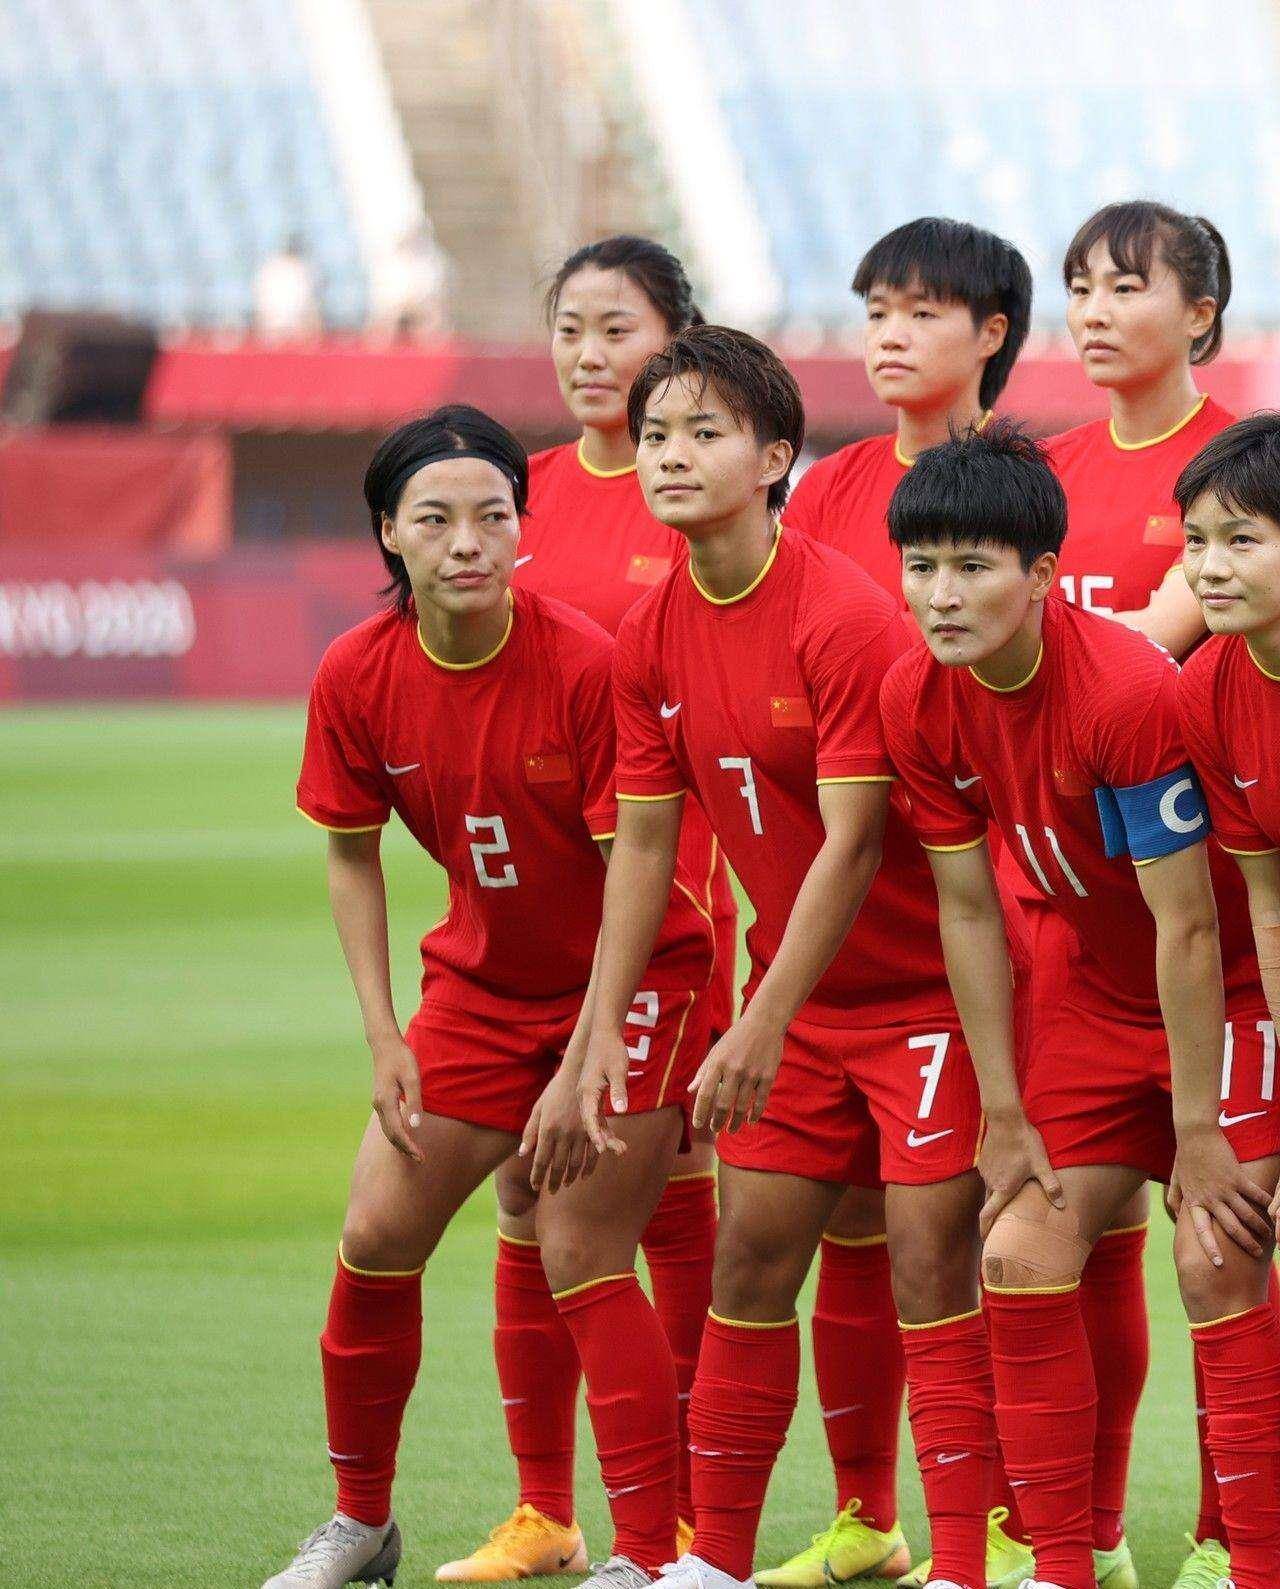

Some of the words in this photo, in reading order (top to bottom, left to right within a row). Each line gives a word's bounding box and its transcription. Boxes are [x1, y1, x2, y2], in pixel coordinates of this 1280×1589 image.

[718, 757, 763, 835] 7
[1159, 778, 1204, 833] C
[465, 814, 518, 888] 2
[1016, 824, 1089, 897] 11
[908, 1032, 950, 1119] 7
[1221, 1020, 1276, 1100] 11
